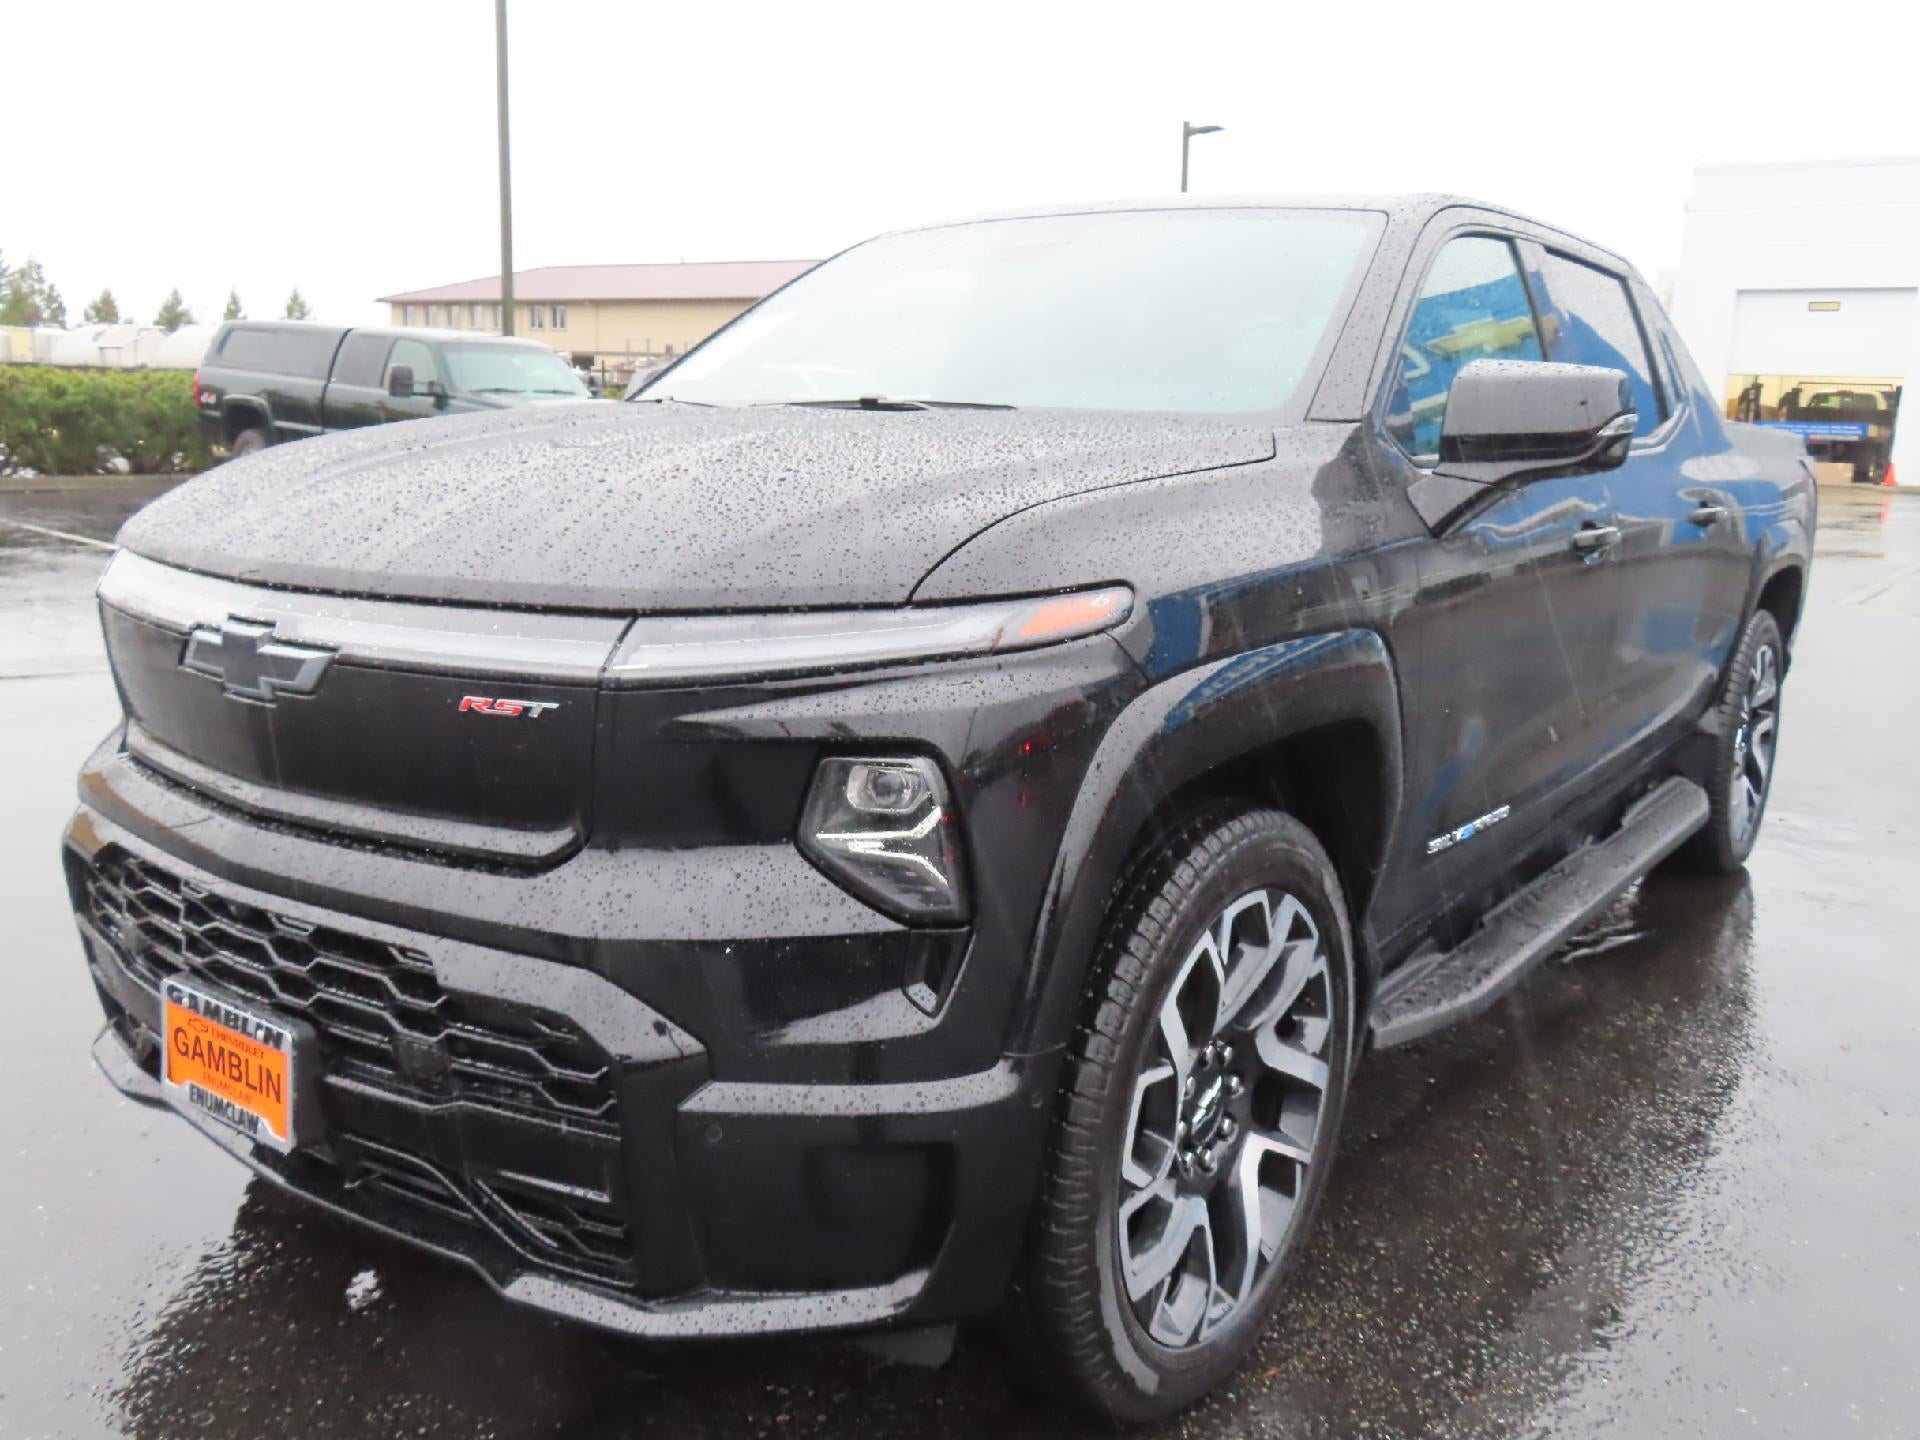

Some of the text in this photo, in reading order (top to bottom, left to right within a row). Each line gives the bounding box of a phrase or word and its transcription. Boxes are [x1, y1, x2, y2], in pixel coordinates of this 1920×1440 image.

[458, 695, 560, 718] RST
[166, 984, 284, 1050] GAMBLIN
[173, 1026, 281, 1104] GAMBLIN
[190, 1083, 259, 1134] ENUMCLAW
